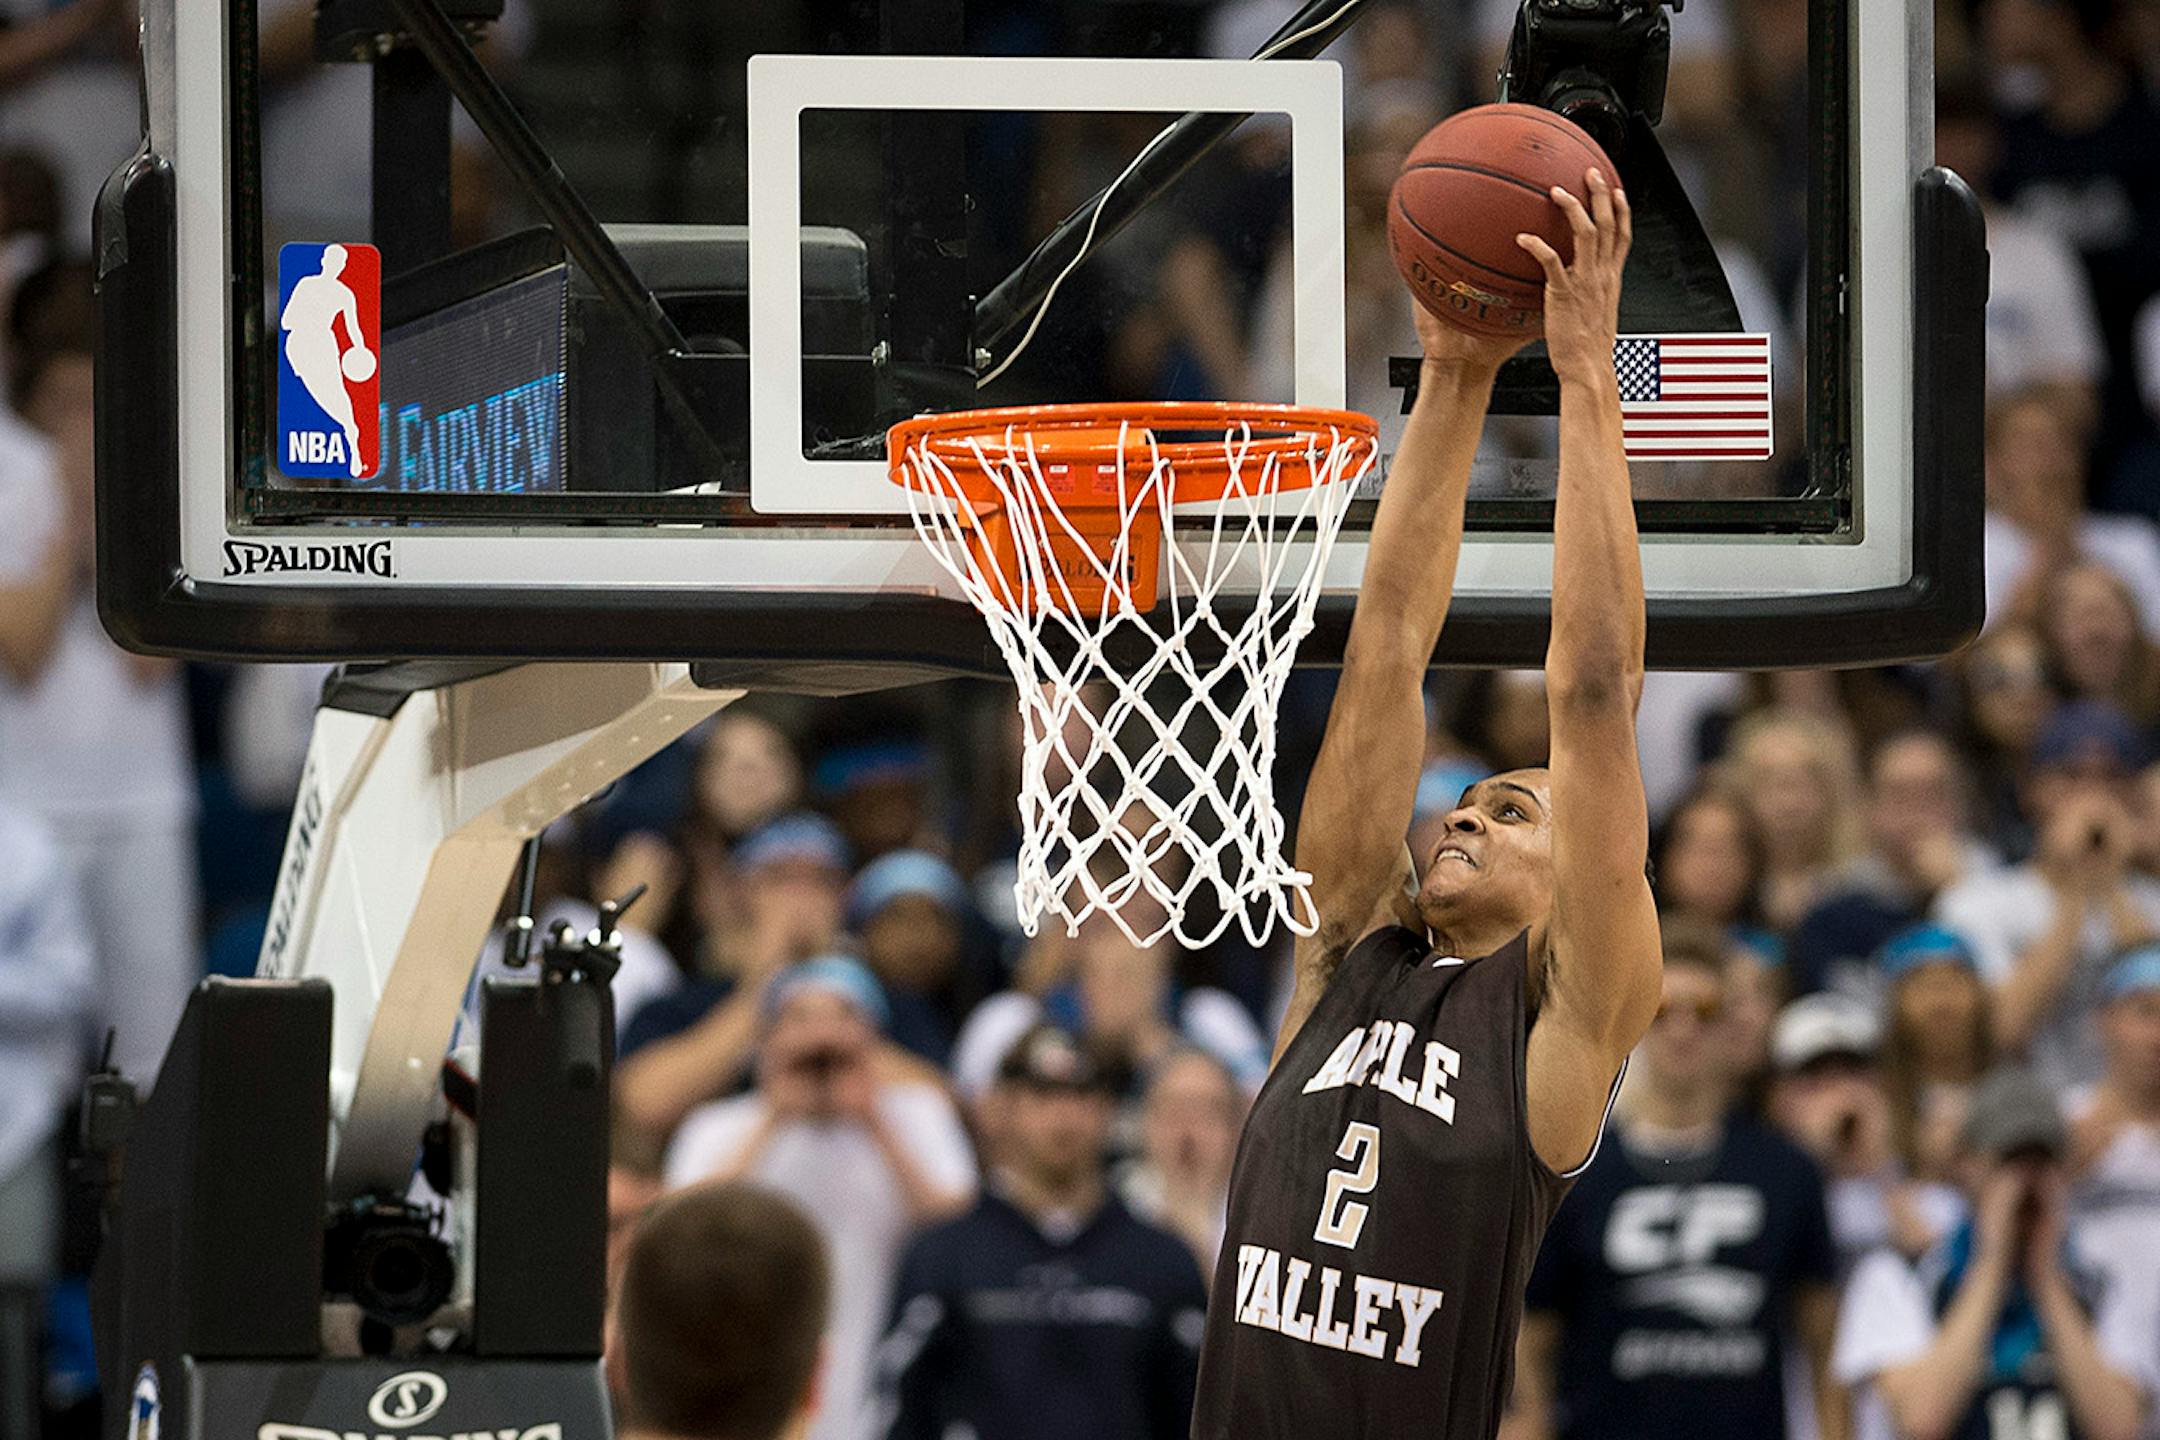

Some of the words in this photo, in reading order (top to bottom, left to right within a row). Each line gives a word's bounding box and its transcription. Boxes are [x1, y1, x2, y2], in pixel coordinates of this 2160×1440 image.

[288, 431, 347, 464] NBA
[399, 372, 564, 491] FAIRVIEW
[223, 539, 392, 578] SPALDING
[1313, 1120, 1381, 1249] 2
[1234, 1243, 1444, 1367] VALLEY
